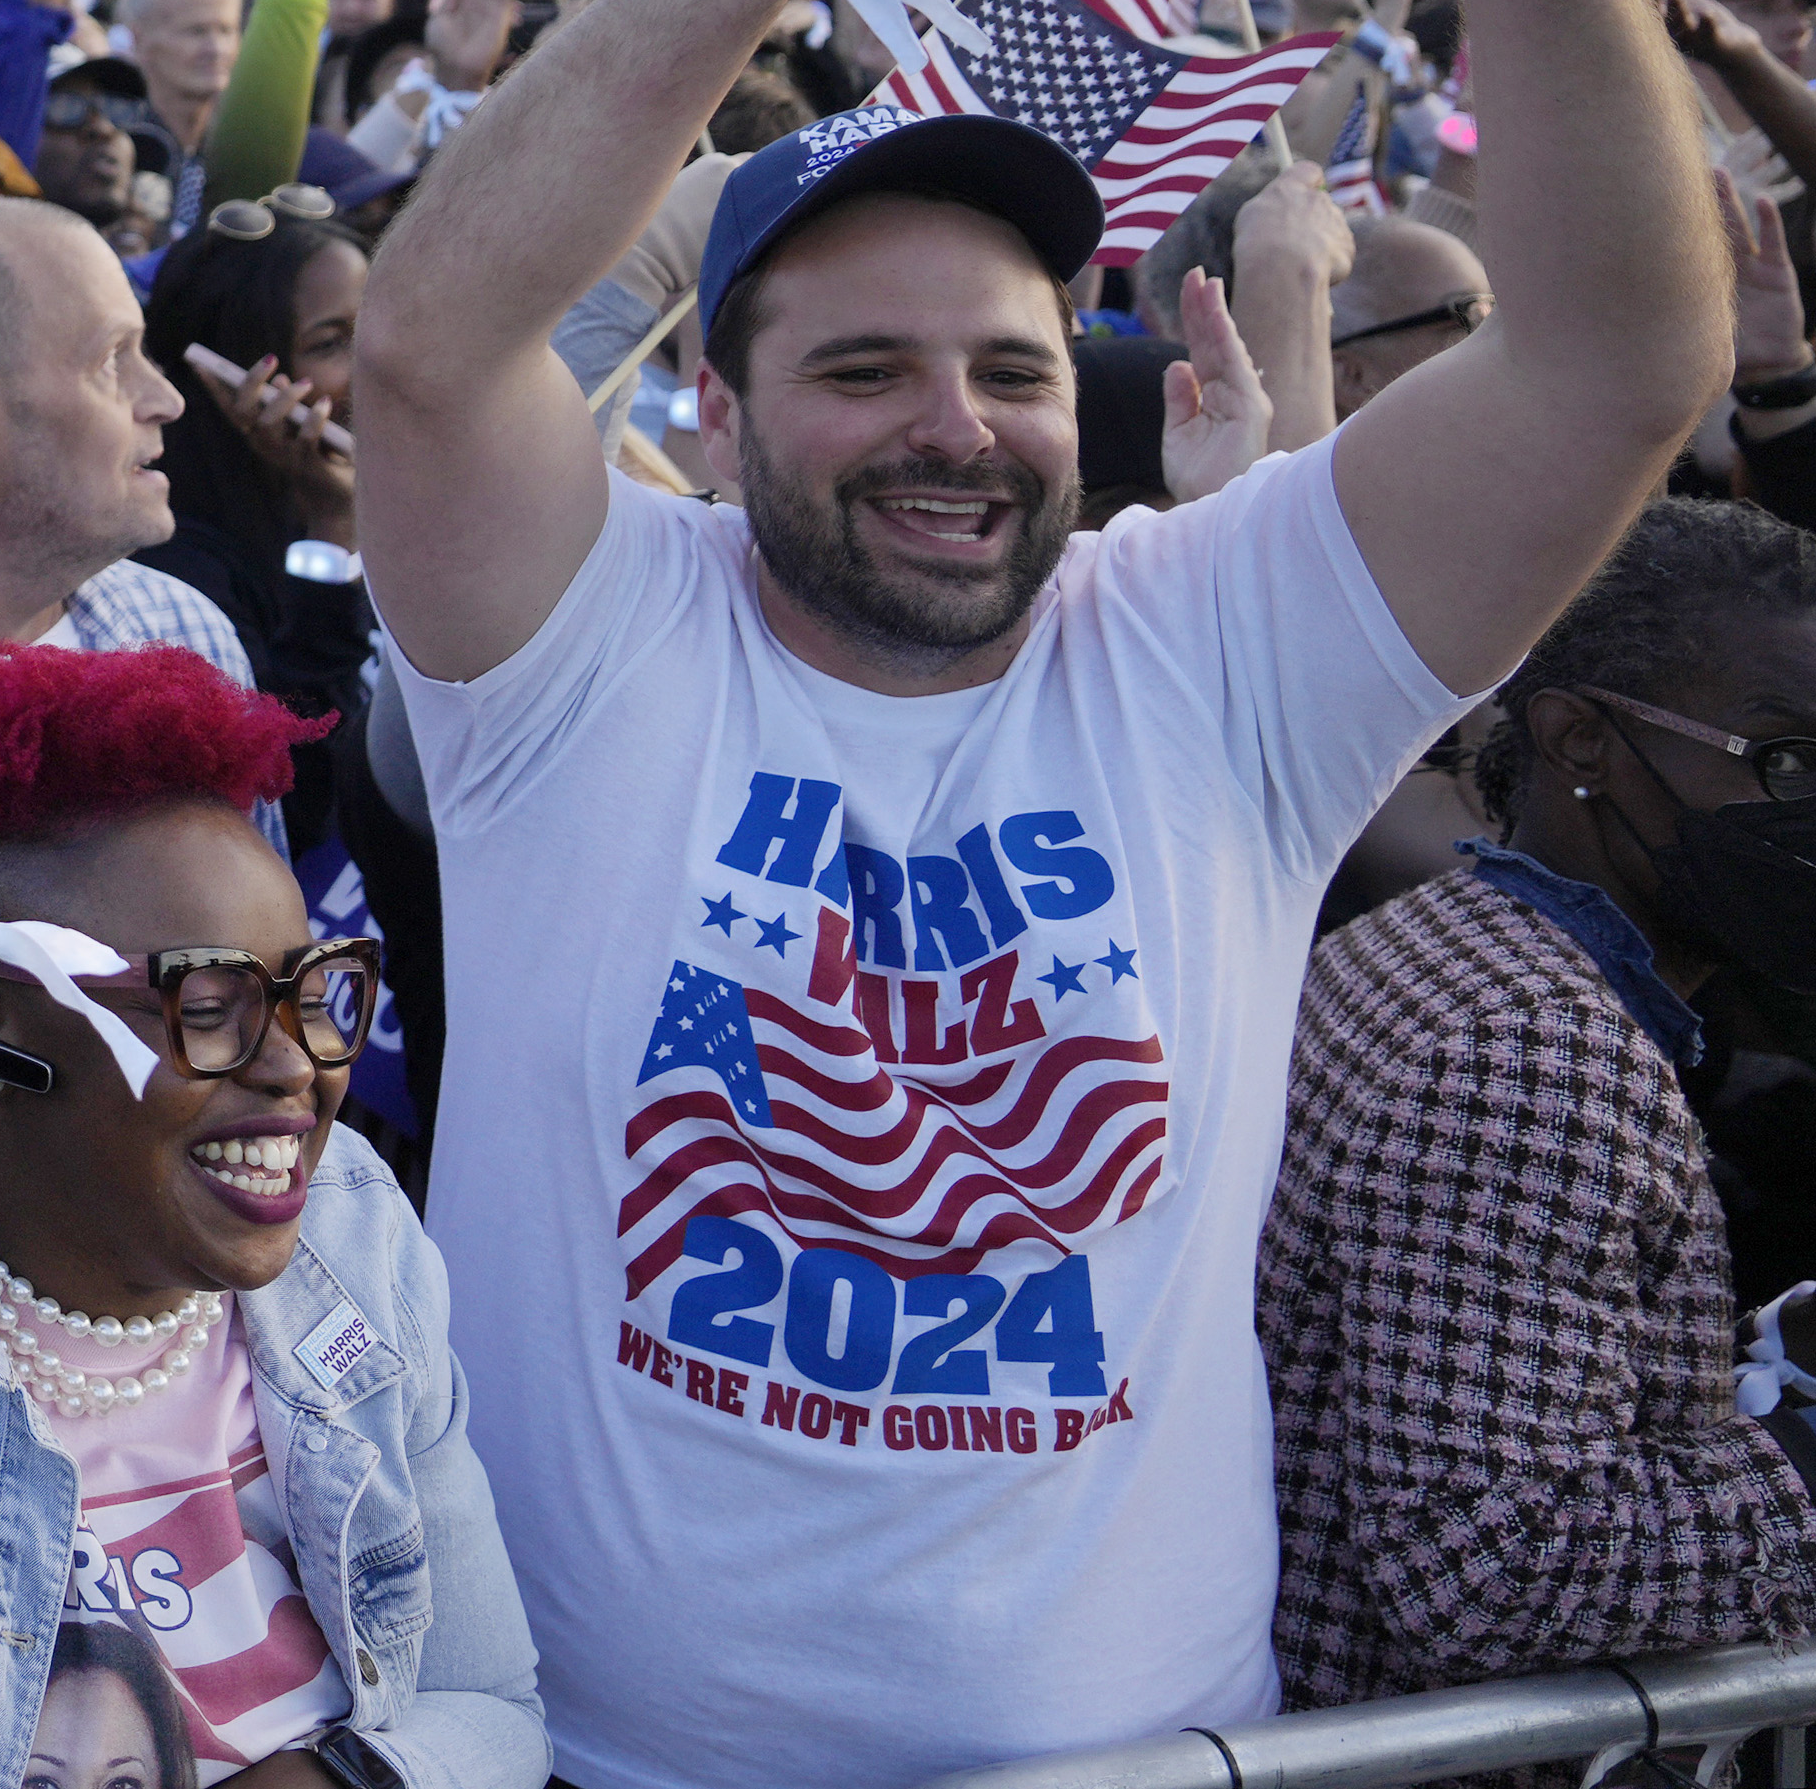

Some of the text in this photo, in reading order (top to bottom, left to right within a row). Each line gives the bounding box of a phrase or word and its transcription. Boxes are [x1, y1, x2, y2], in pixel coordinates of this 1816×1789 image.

[799, 108, 925, 144] KAMA
[809, 122, 897, 154] HAR
[797, 164, 838, 186] FO
[806, 146, 857, 169] 2024
[668, 1214, 1108, 1398] 2024
[318, 1318, 365, 1367] HARRIS
[331, 1333, 372, 1374] WALZ
[761, 1381, 870, 1447] NOT
[882, 1404, 1037, 1454] GOING
[63, 1528, 193, 1631] RIS
